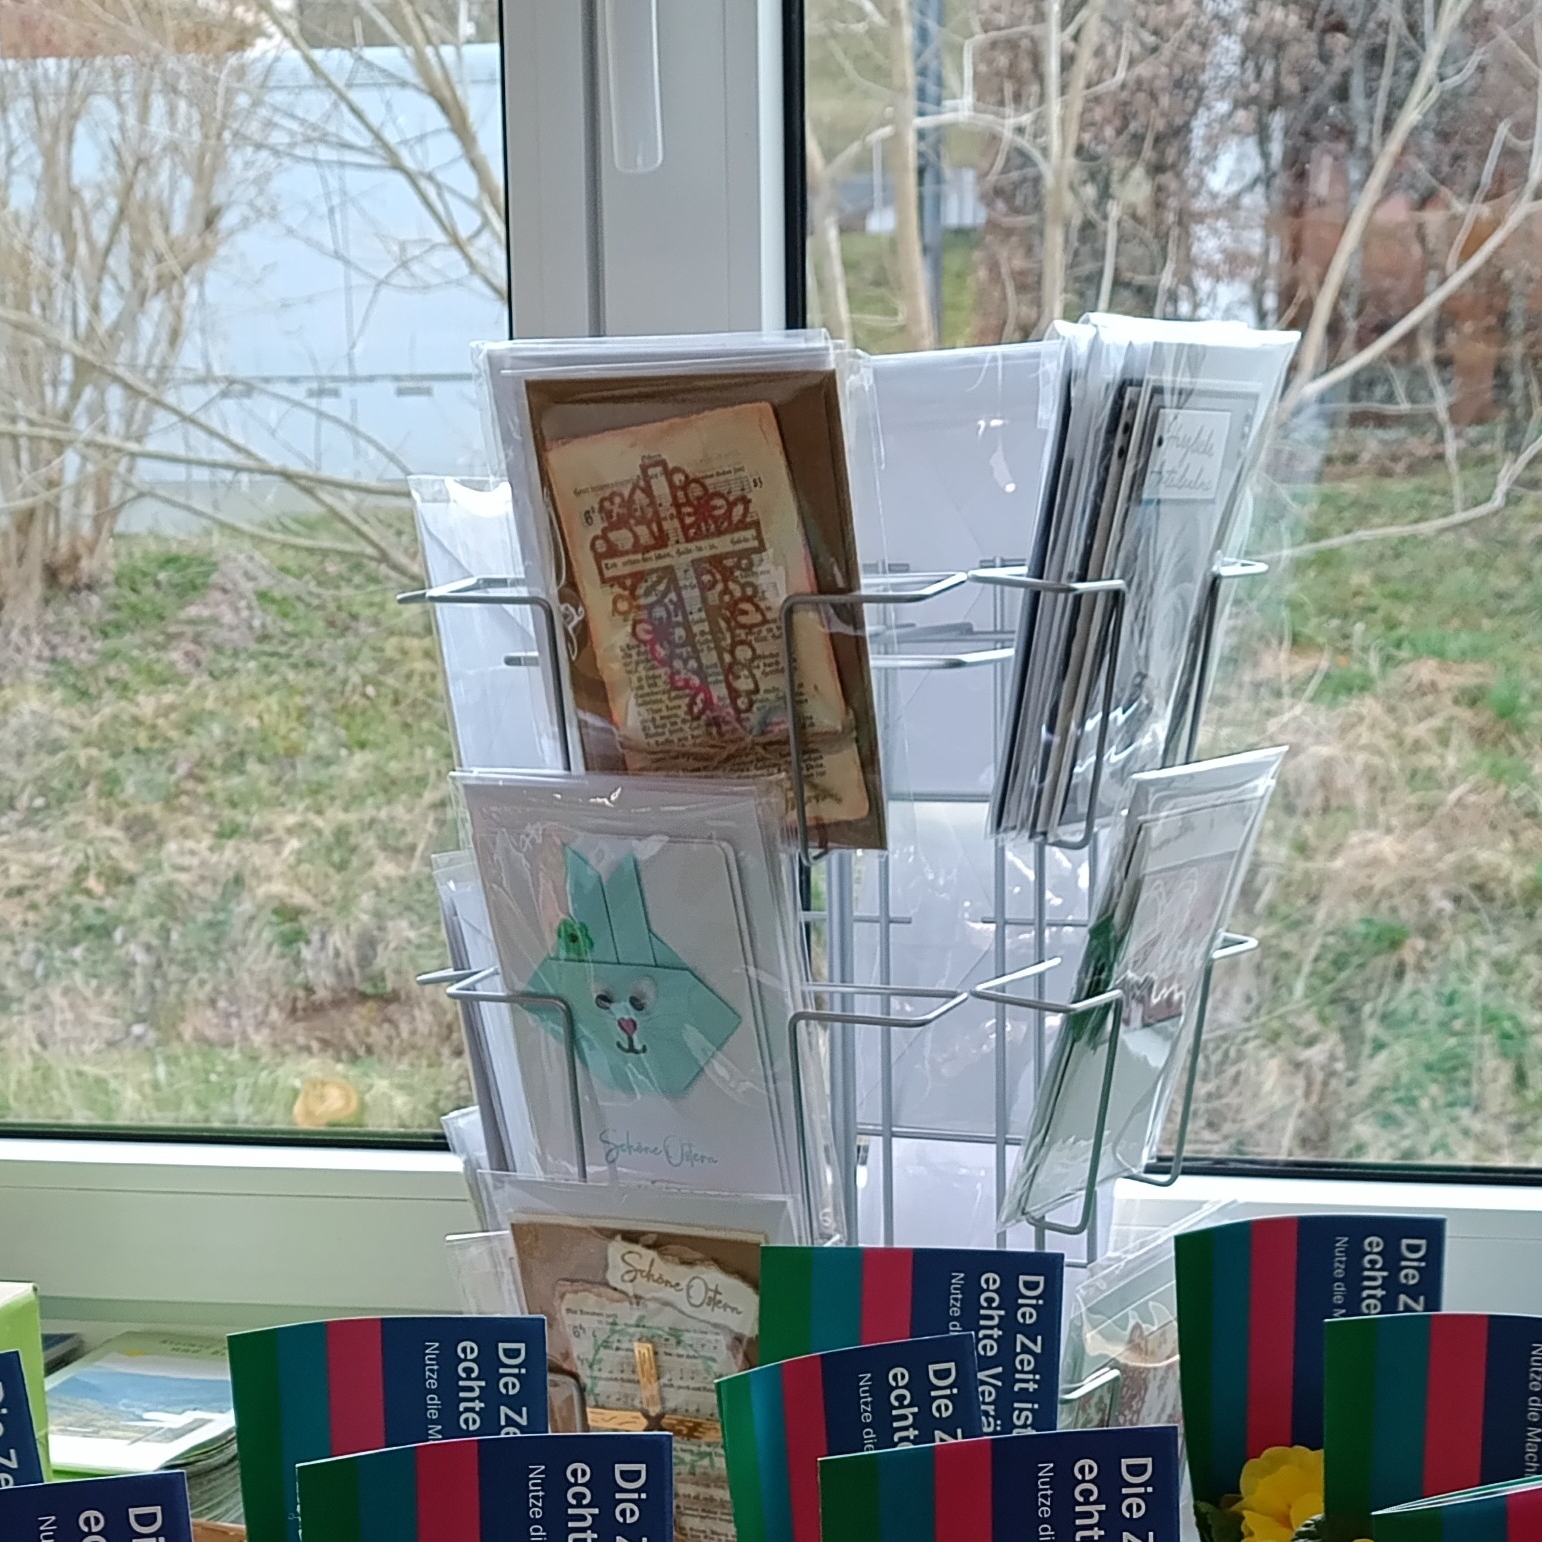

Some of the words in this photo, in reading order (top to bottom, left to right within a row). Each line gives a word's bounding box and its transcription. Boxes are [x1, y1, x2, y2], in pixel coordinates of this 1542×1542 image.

[620, 1251, 684, 1292] Schöne
[686, 1276, 743, 1315] Ostern
[1333, 1236, 1350, 1278] Nutze
[1360, 1235, 1389, 1315] echte
[1399, 1238, 1427, 1285] Die
[948, 1272, 965, 1317] Nutze
[977, 1272, 1006, 1357] echte
[1016, 1274, 1045, 1324] Die
[1332, 1282, 1347, 1304] die
[425, 1342, 440, 1389] Nutze
[457, 1341, 486, 1431] echte
[498, 1342, 526, 1395] Die
[928, 1361, 959, 1419] Die
[1013, 1335, 1042, 1392] Zeit
[426, 1394, 442, 1420] die
[858, 1372, 873, 1423] Nutze
[862, 1428, 878, 1452] die
[528, 1465, 546, 1519] Nutze
[614, 1463, 647, 1524] Die
[1037, 1463, 1054, 1518] Nutze
[1120, 1456, 1154, 1519] Die
